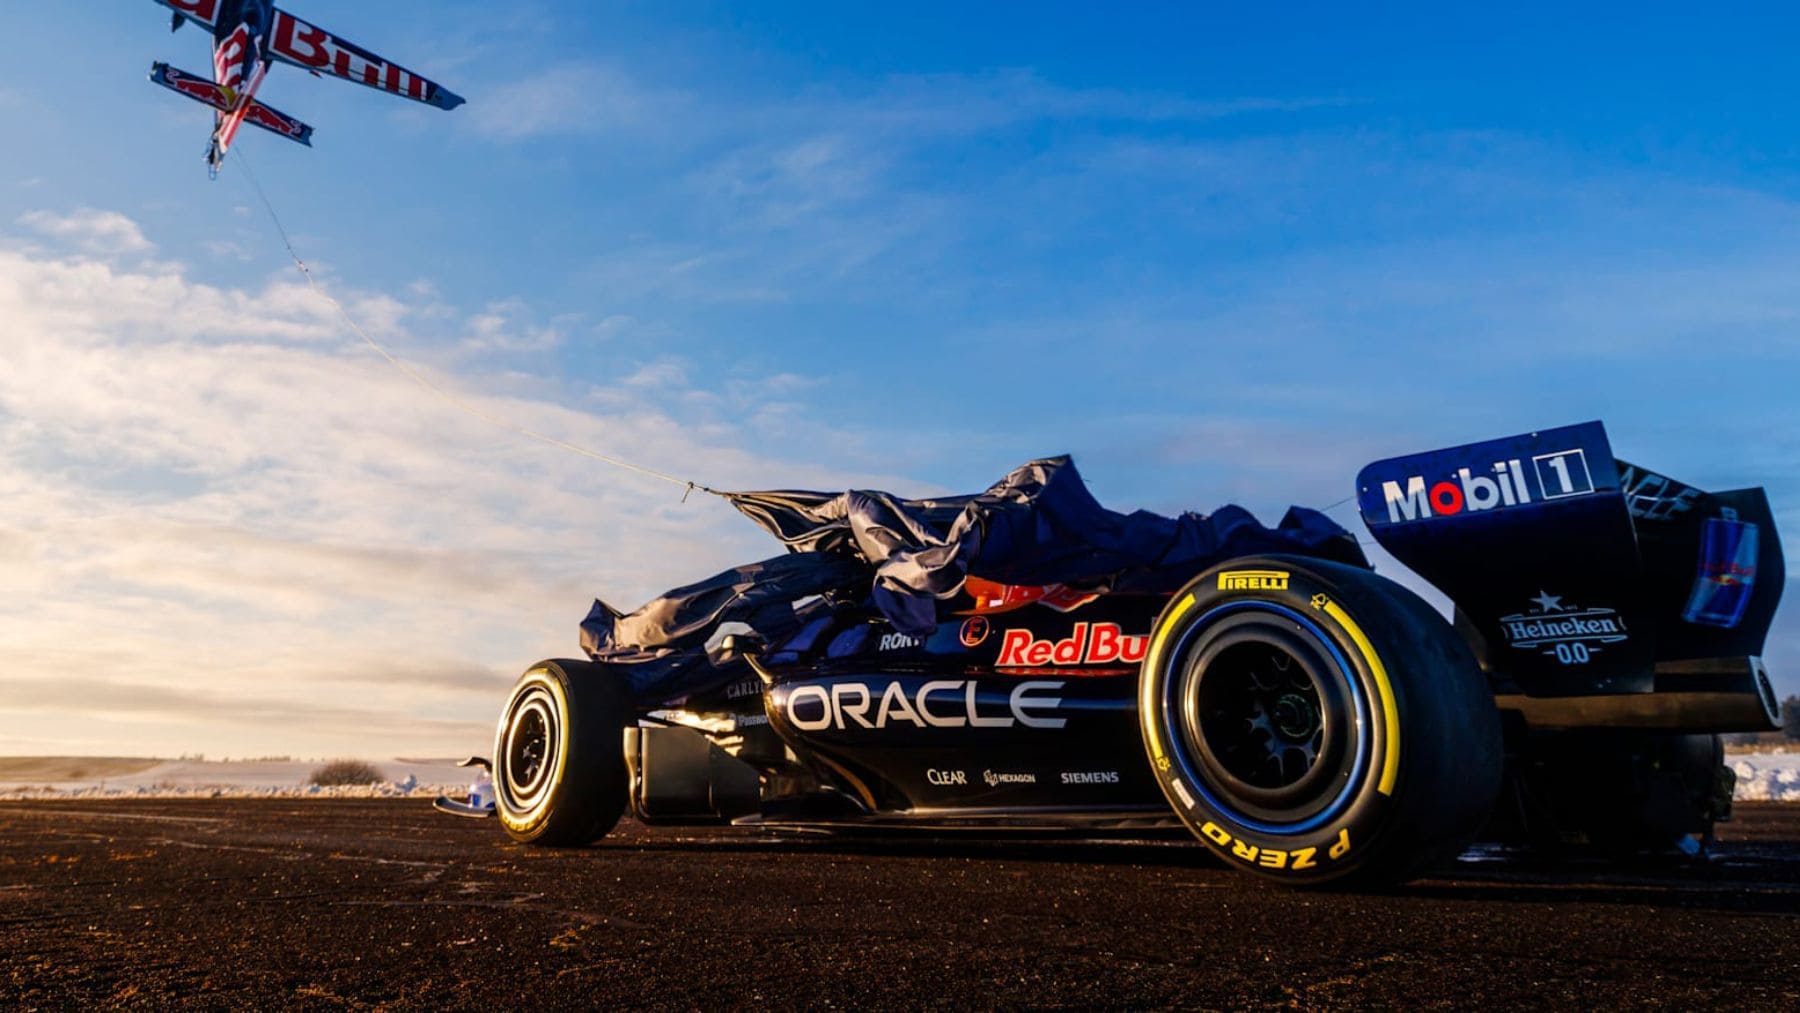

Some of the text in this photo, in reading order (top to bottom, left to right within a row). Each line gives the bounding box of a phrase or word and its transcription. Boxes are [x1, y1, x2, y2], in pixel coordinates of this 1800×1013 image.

[1382, 456, 1575, 523] Mobil 1
[1217, 570, 1290, 591] PIRELLI
[1509, 617, 1619, 639] Heineken
[994, 621, 1151, 667] Red Bu
[1555, 642, 1590, 664] 0.0
[786, 681, 1068, 731] ORACLE
[927, 768, 967, 785] CLEAR
[1000, 773, 1036, 783] HEXAGON
[1060, 771, 1120, 784] SIEMENS
[1201, 821, 1351, 869] P ZERO
